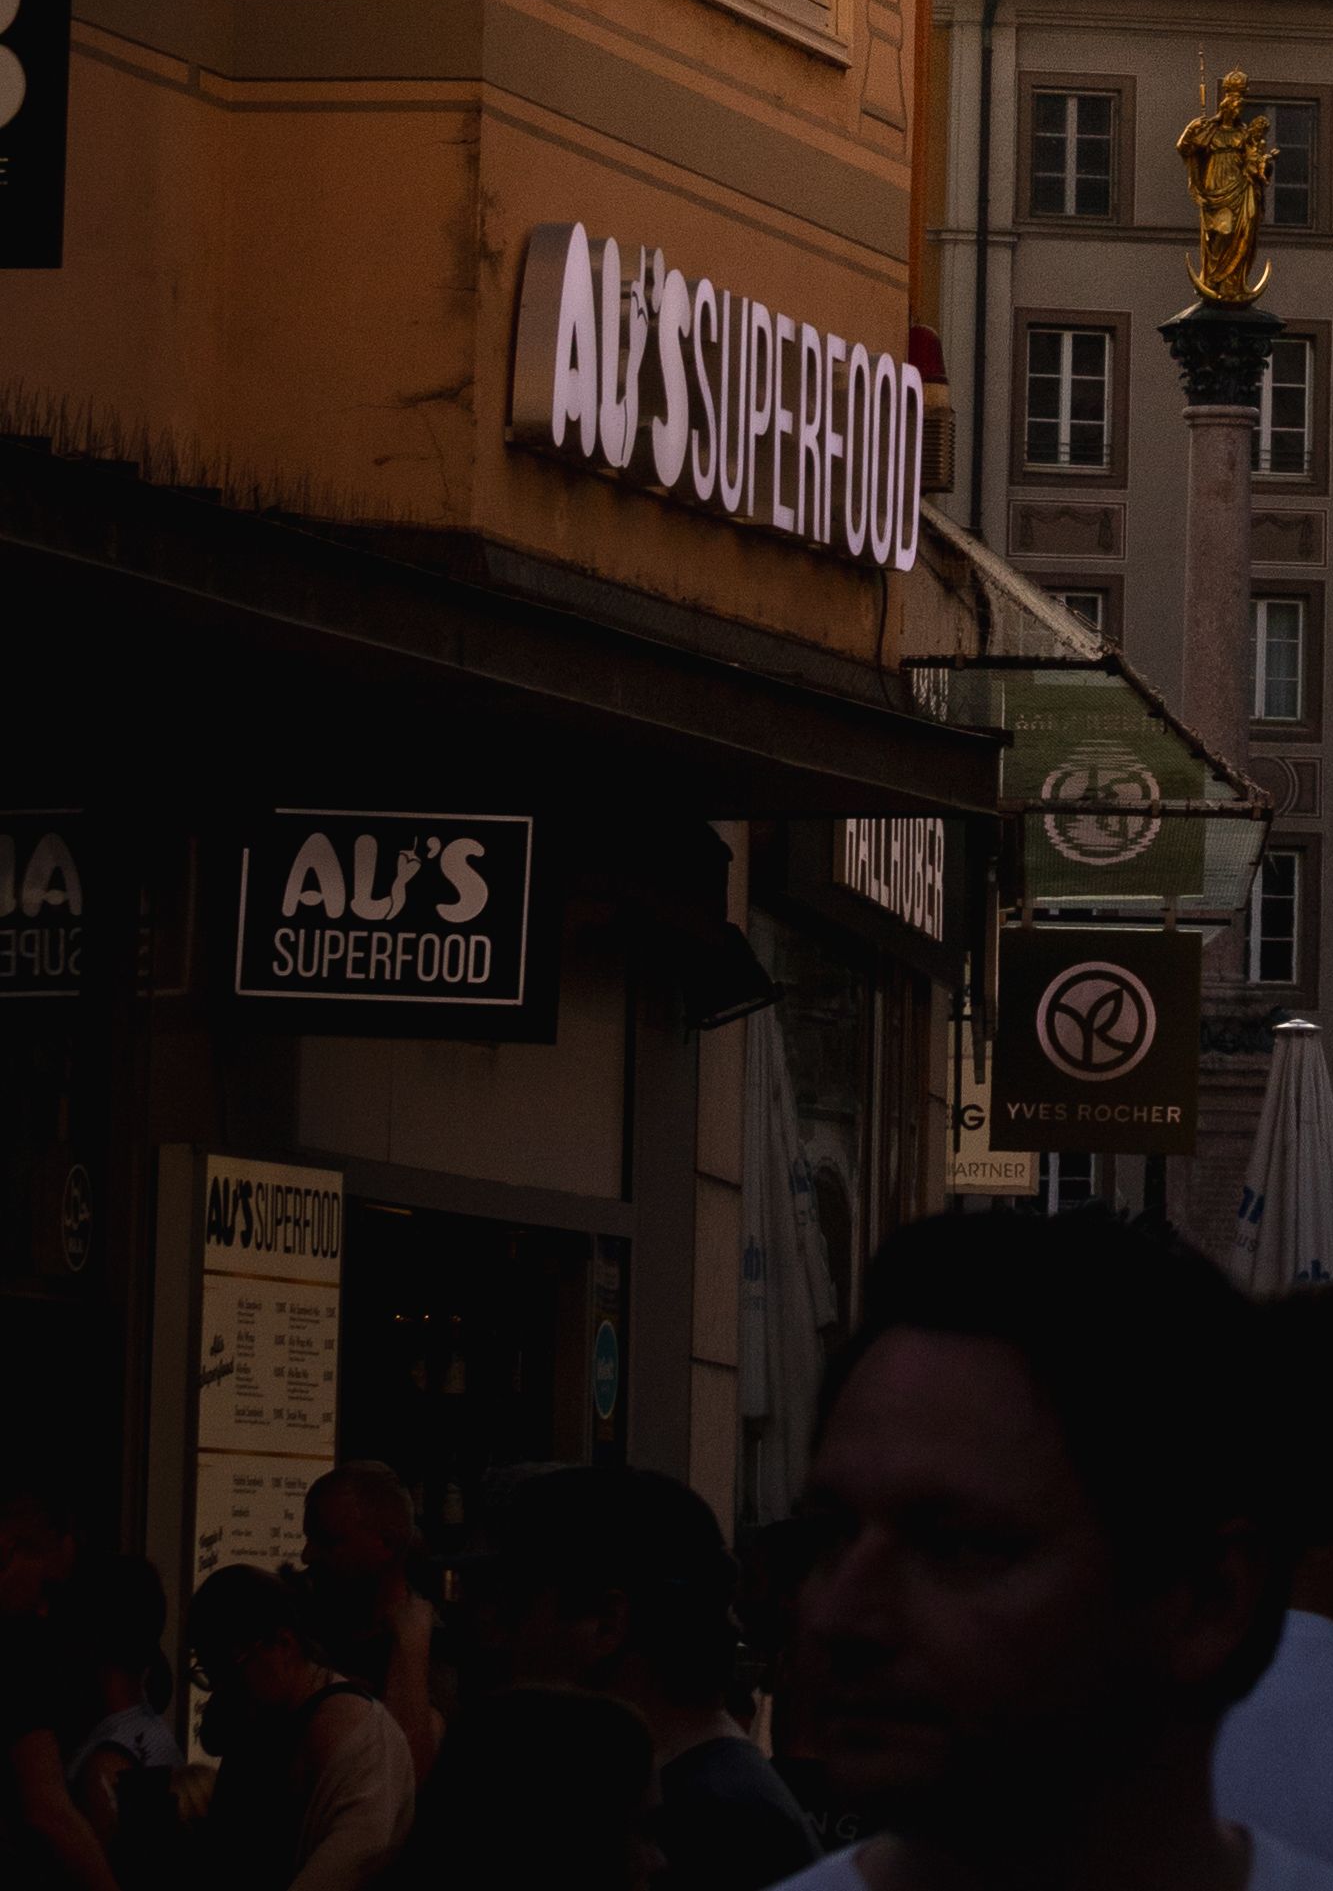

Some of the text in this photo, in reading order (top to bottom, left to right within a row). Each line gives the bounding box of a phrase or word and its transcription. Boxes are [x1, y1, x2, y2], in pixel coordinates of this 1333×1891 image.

[691, 278, 925, 572] SUPERFOOD
[272, 926, 493, 985] SUPERFOOD
[1006, 1102, 1182, 1124] YVES ROCHER
[255, 1182, 341, 1259] SUPERFOOD
